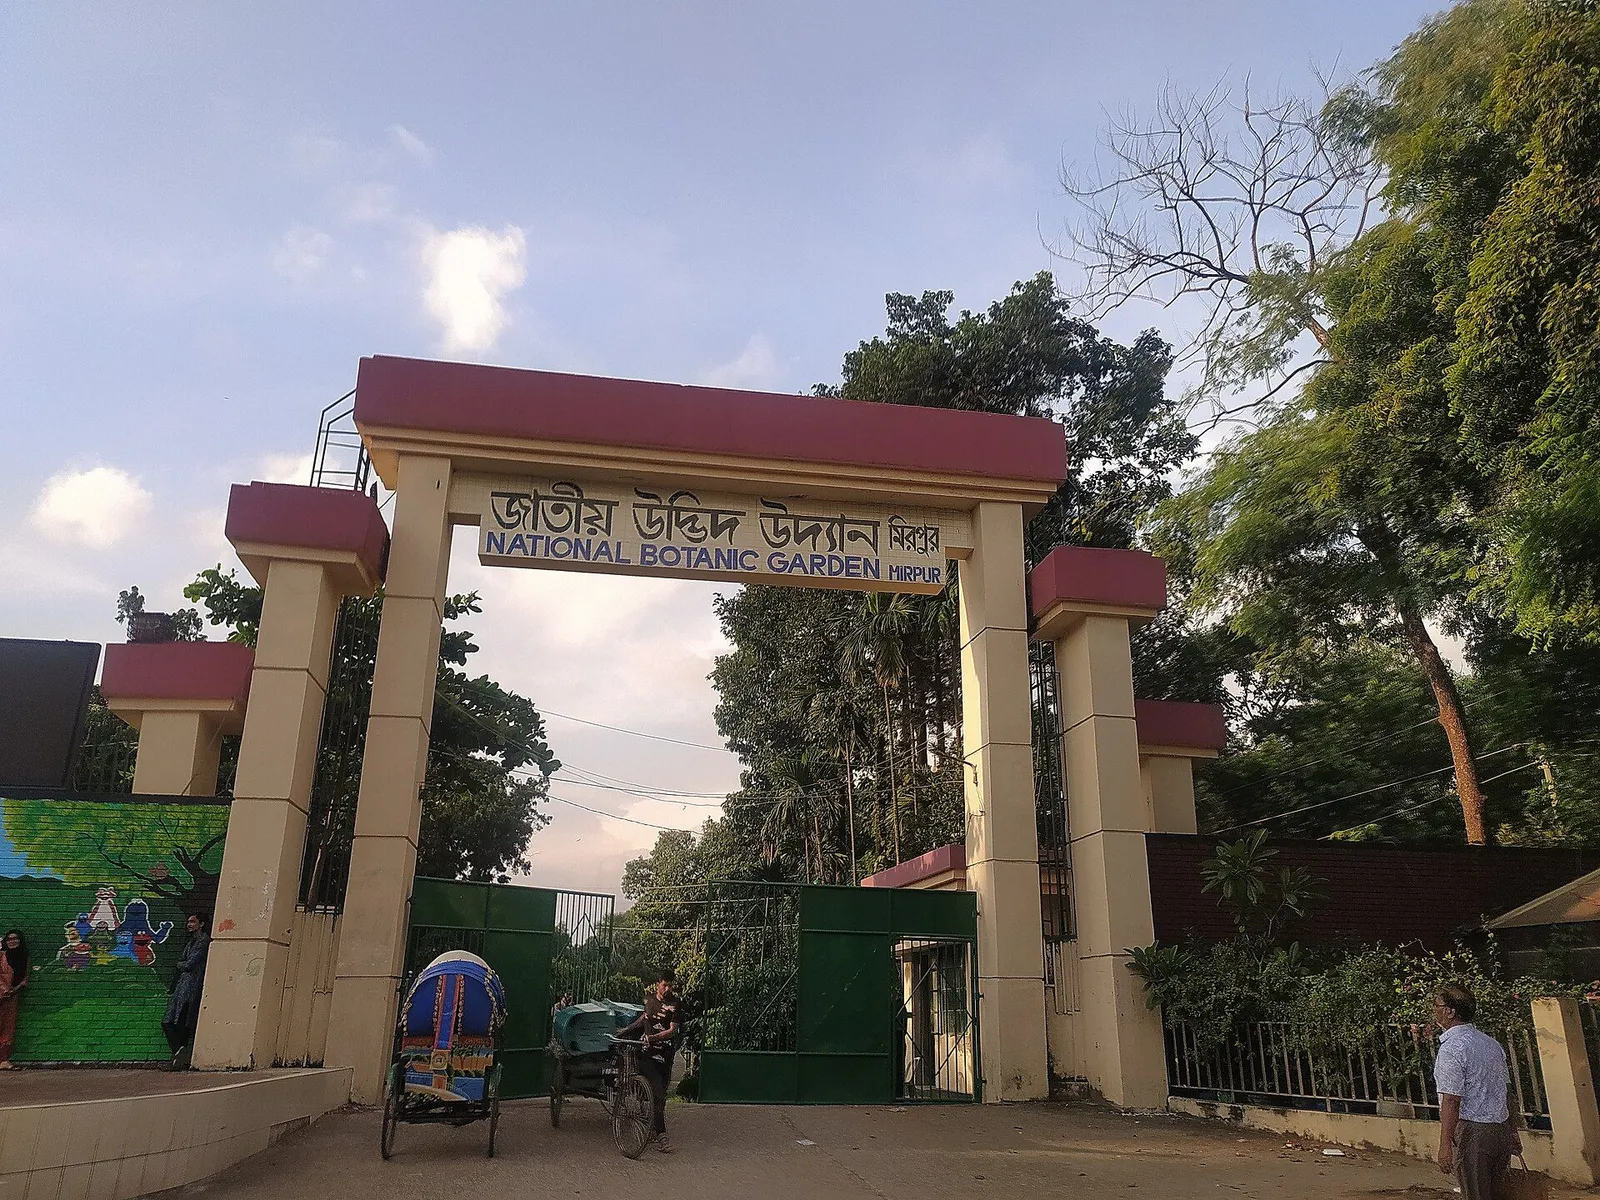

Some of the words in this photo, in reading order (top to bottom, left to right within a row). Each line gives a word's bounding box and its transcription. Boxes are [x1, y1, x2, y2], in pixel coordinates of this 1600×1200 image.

[491, 482, 619, 536] জাতীয়
[632, 487, 746, 545] উদ্ভিদ
[759, 498, 880, 556] উদ্যান
[888, 514, 940, 557] মিরপুর
[486, 531, 631, 564] NATIONAL
[640, 543, 759, 571] BOTANIC
[767, 551, 880, 579] GARDEN
[888, 564, 941, 584] MIRPUR
